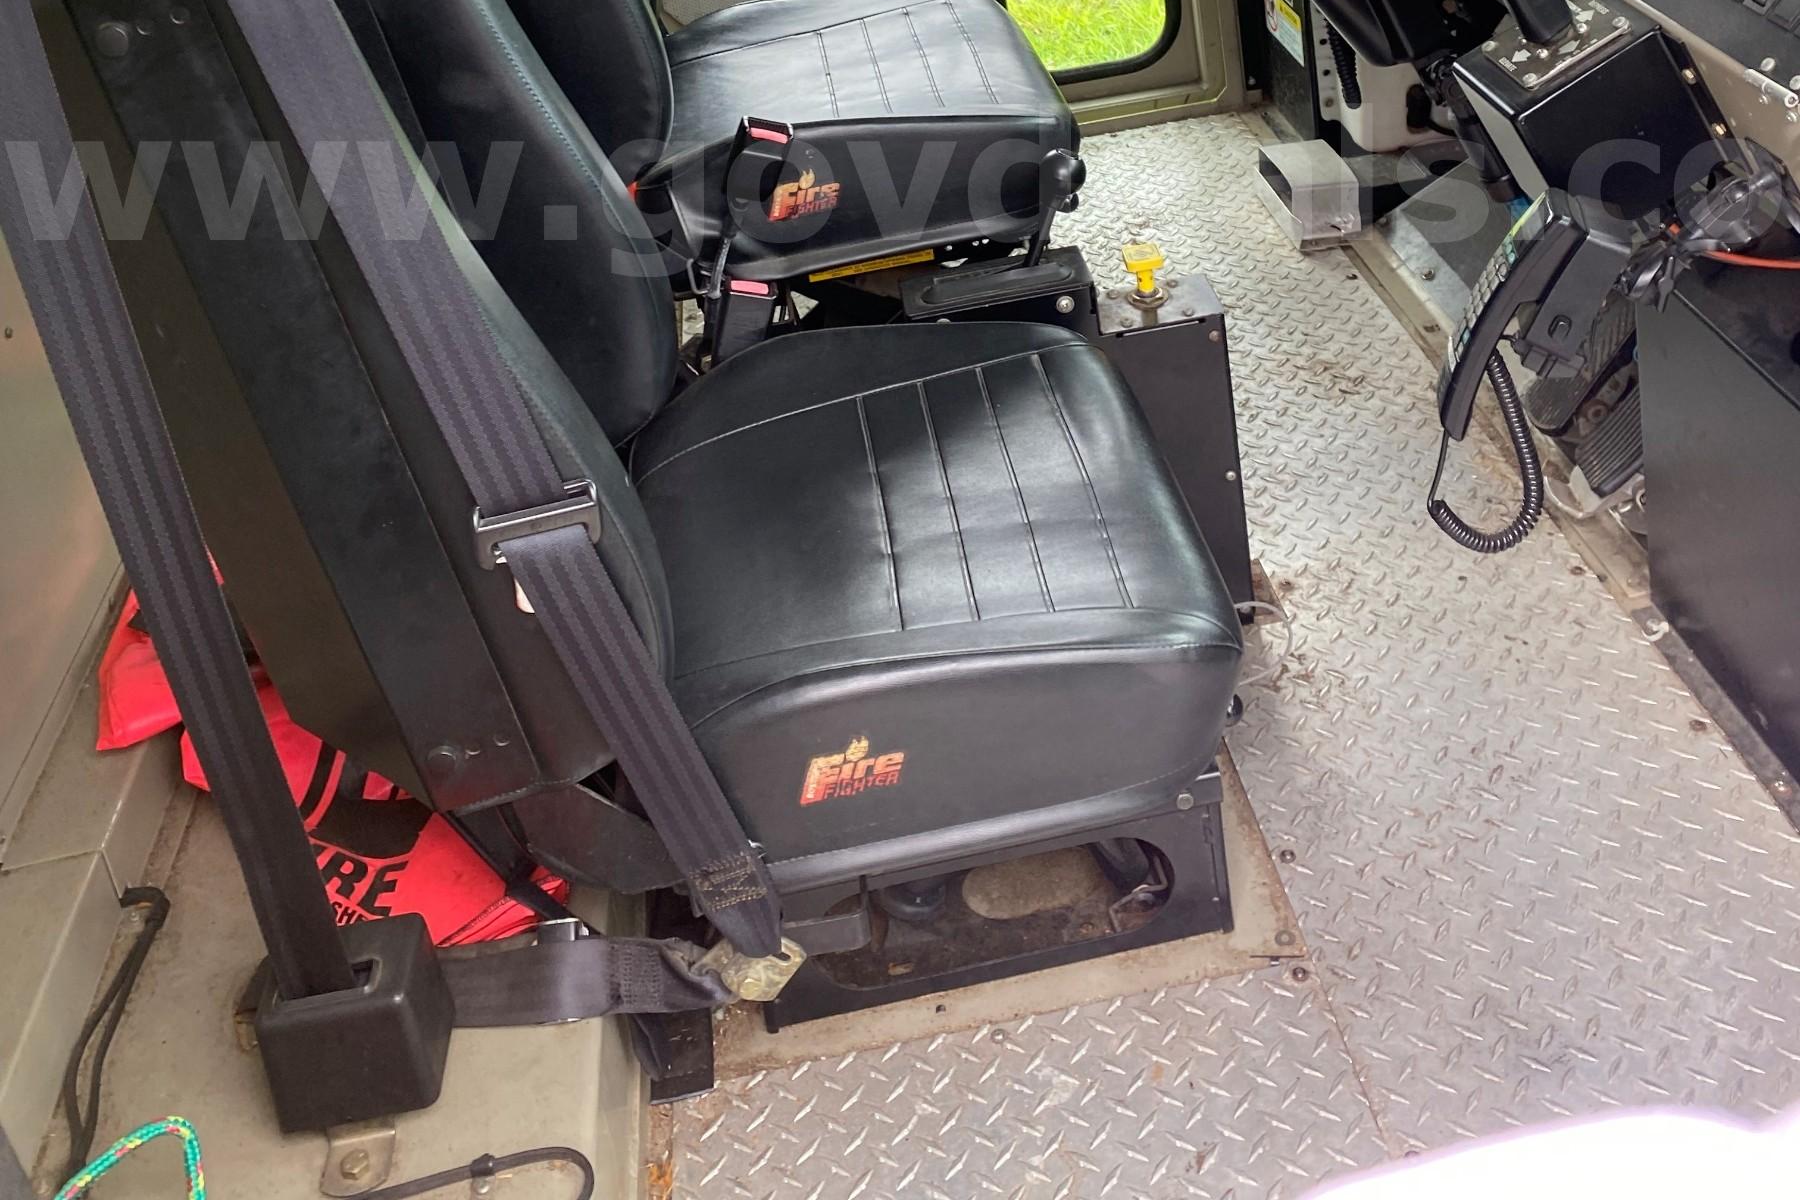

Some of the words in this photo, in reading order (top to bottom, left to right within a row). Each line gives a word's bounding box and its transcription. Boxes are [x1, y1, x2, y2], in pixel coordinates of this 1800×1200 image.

[800, 735, 905, 807] Fire
[824, 772, 899, 800] FIGHTER
[312, 843, 409, 917] RE
